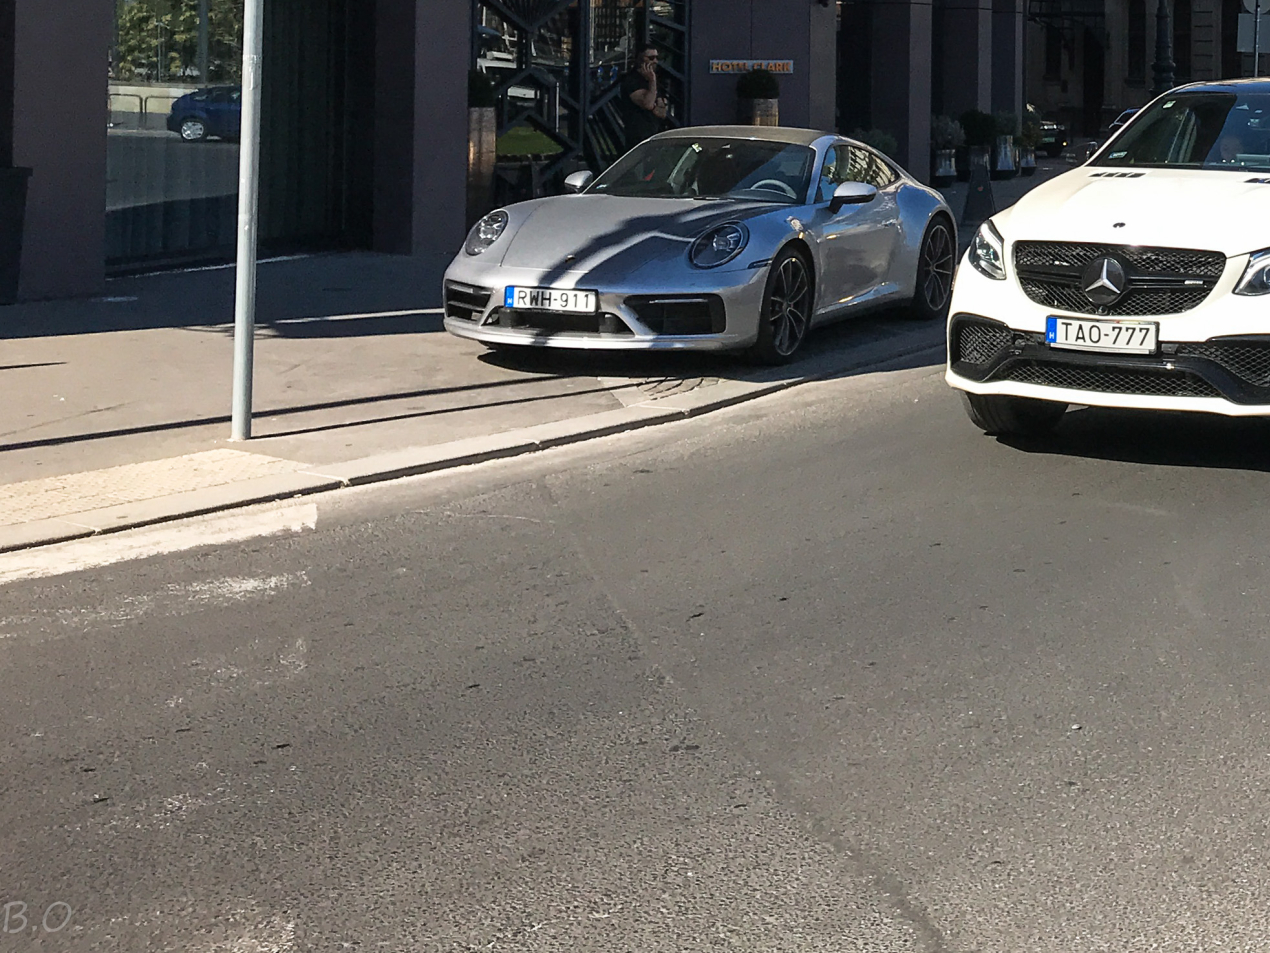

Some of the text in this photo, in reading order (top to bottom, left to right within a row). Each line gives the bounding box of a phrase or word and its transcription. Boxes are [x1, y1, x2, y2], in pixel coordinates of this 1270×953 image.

[712, 62, 792, 72] HOTEL CLARK
[517, 290, 589, 308] RWH-911
[1061, 322, 1150, 346] TAO-777
